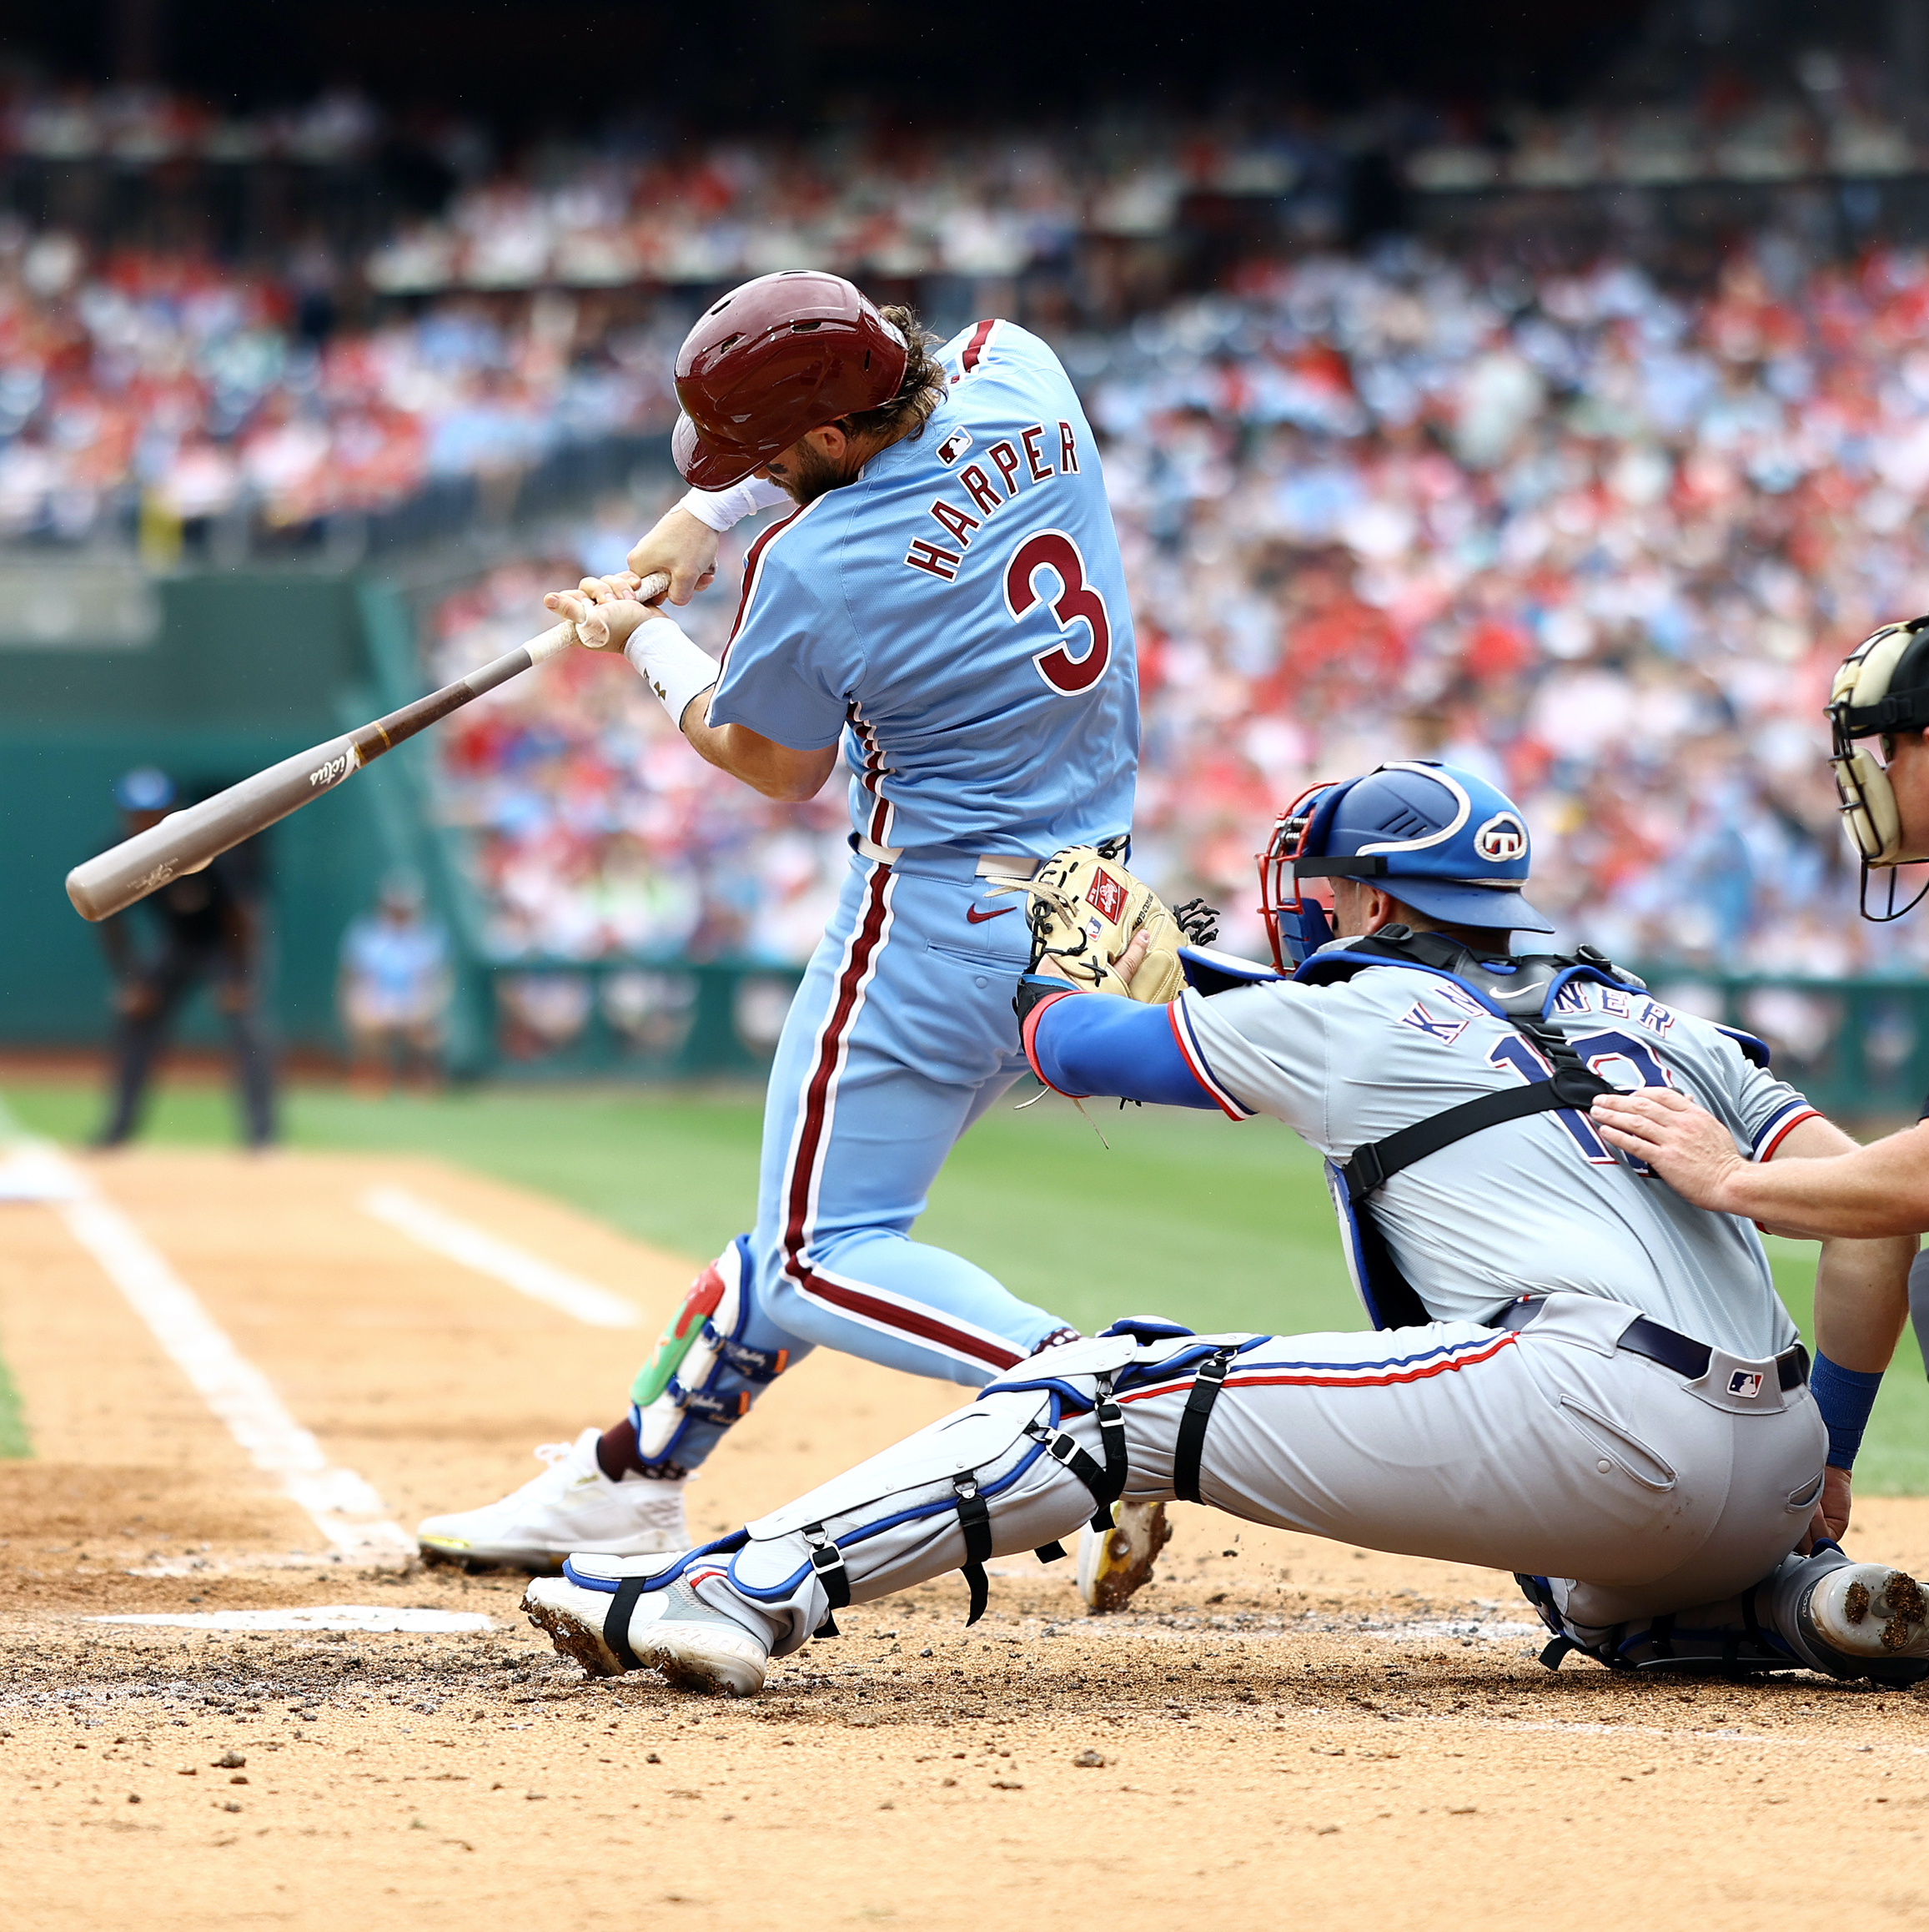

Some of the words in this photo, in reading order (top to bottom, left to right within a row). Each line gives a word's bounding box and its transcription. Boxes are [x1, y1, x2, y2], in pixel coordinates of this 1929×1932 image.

[903, 419, 1081, 583] HARPER
[1002, 528, 1113, 697] 3
[309, 746, 361, 787] Victus
[1394, 981, 1675, 1046] KNNER
